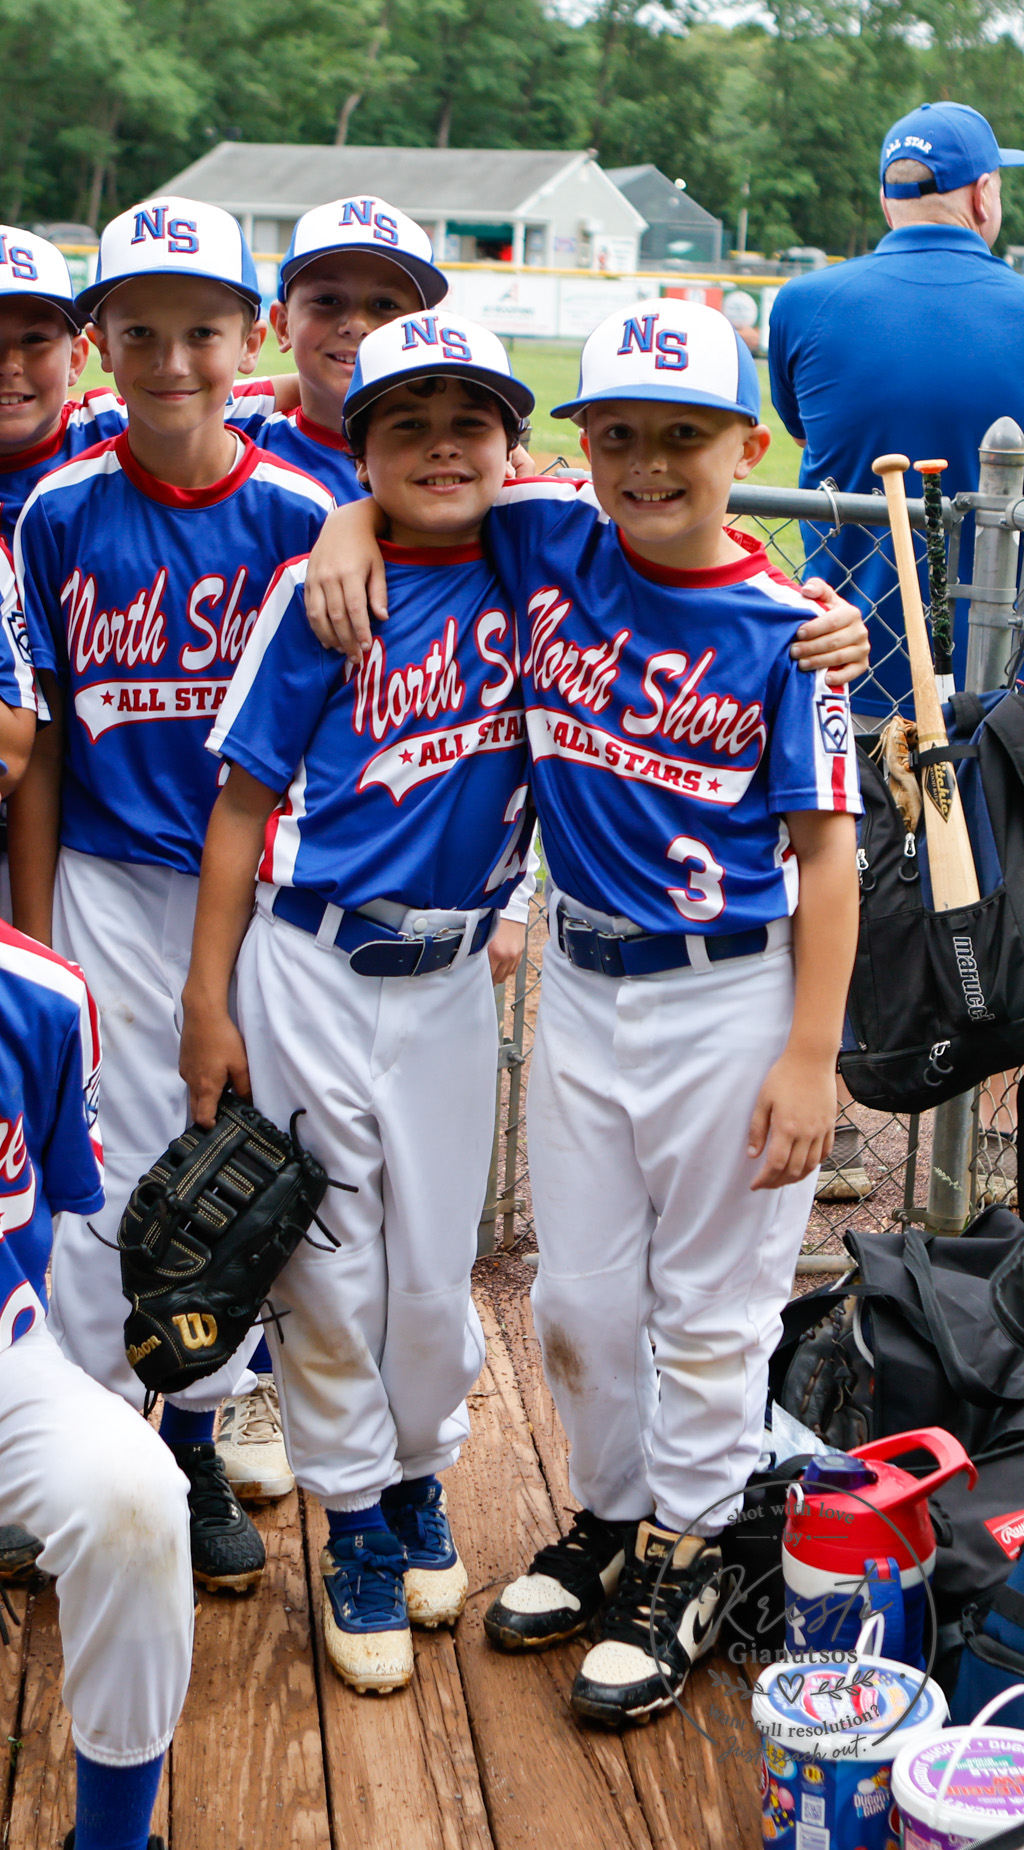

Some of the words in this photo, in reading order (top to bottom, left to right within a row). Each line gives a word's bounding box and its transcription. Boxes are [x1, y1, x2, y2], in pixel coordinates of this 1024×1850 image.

[886, 139, 902, 158] ALL
[904, 136, 933, 154] STAR
[130, 205, 200, 254] NS
[338, 200, 399, 246] NS
[401, 316, 473, 362] NS
[617, 313, 688, 371] NS
[60, 565, 169, 676] North
[117, 688, 166, 712] ALL
[175, 686, 228, 711] STA
[344, 616, 467, 742] North
[523, 586, 632, 715] North
[621, 646, 767, 758] Shore
[418, 732, 469, 768] ALL
[553, 721, 600, 760] ALL
[604, 740, 704, 793] STARS
[933, 761, 953, 817] itchie
[665, 834, 727, 923] 3
[952, 936, 996, 1021] marucci
